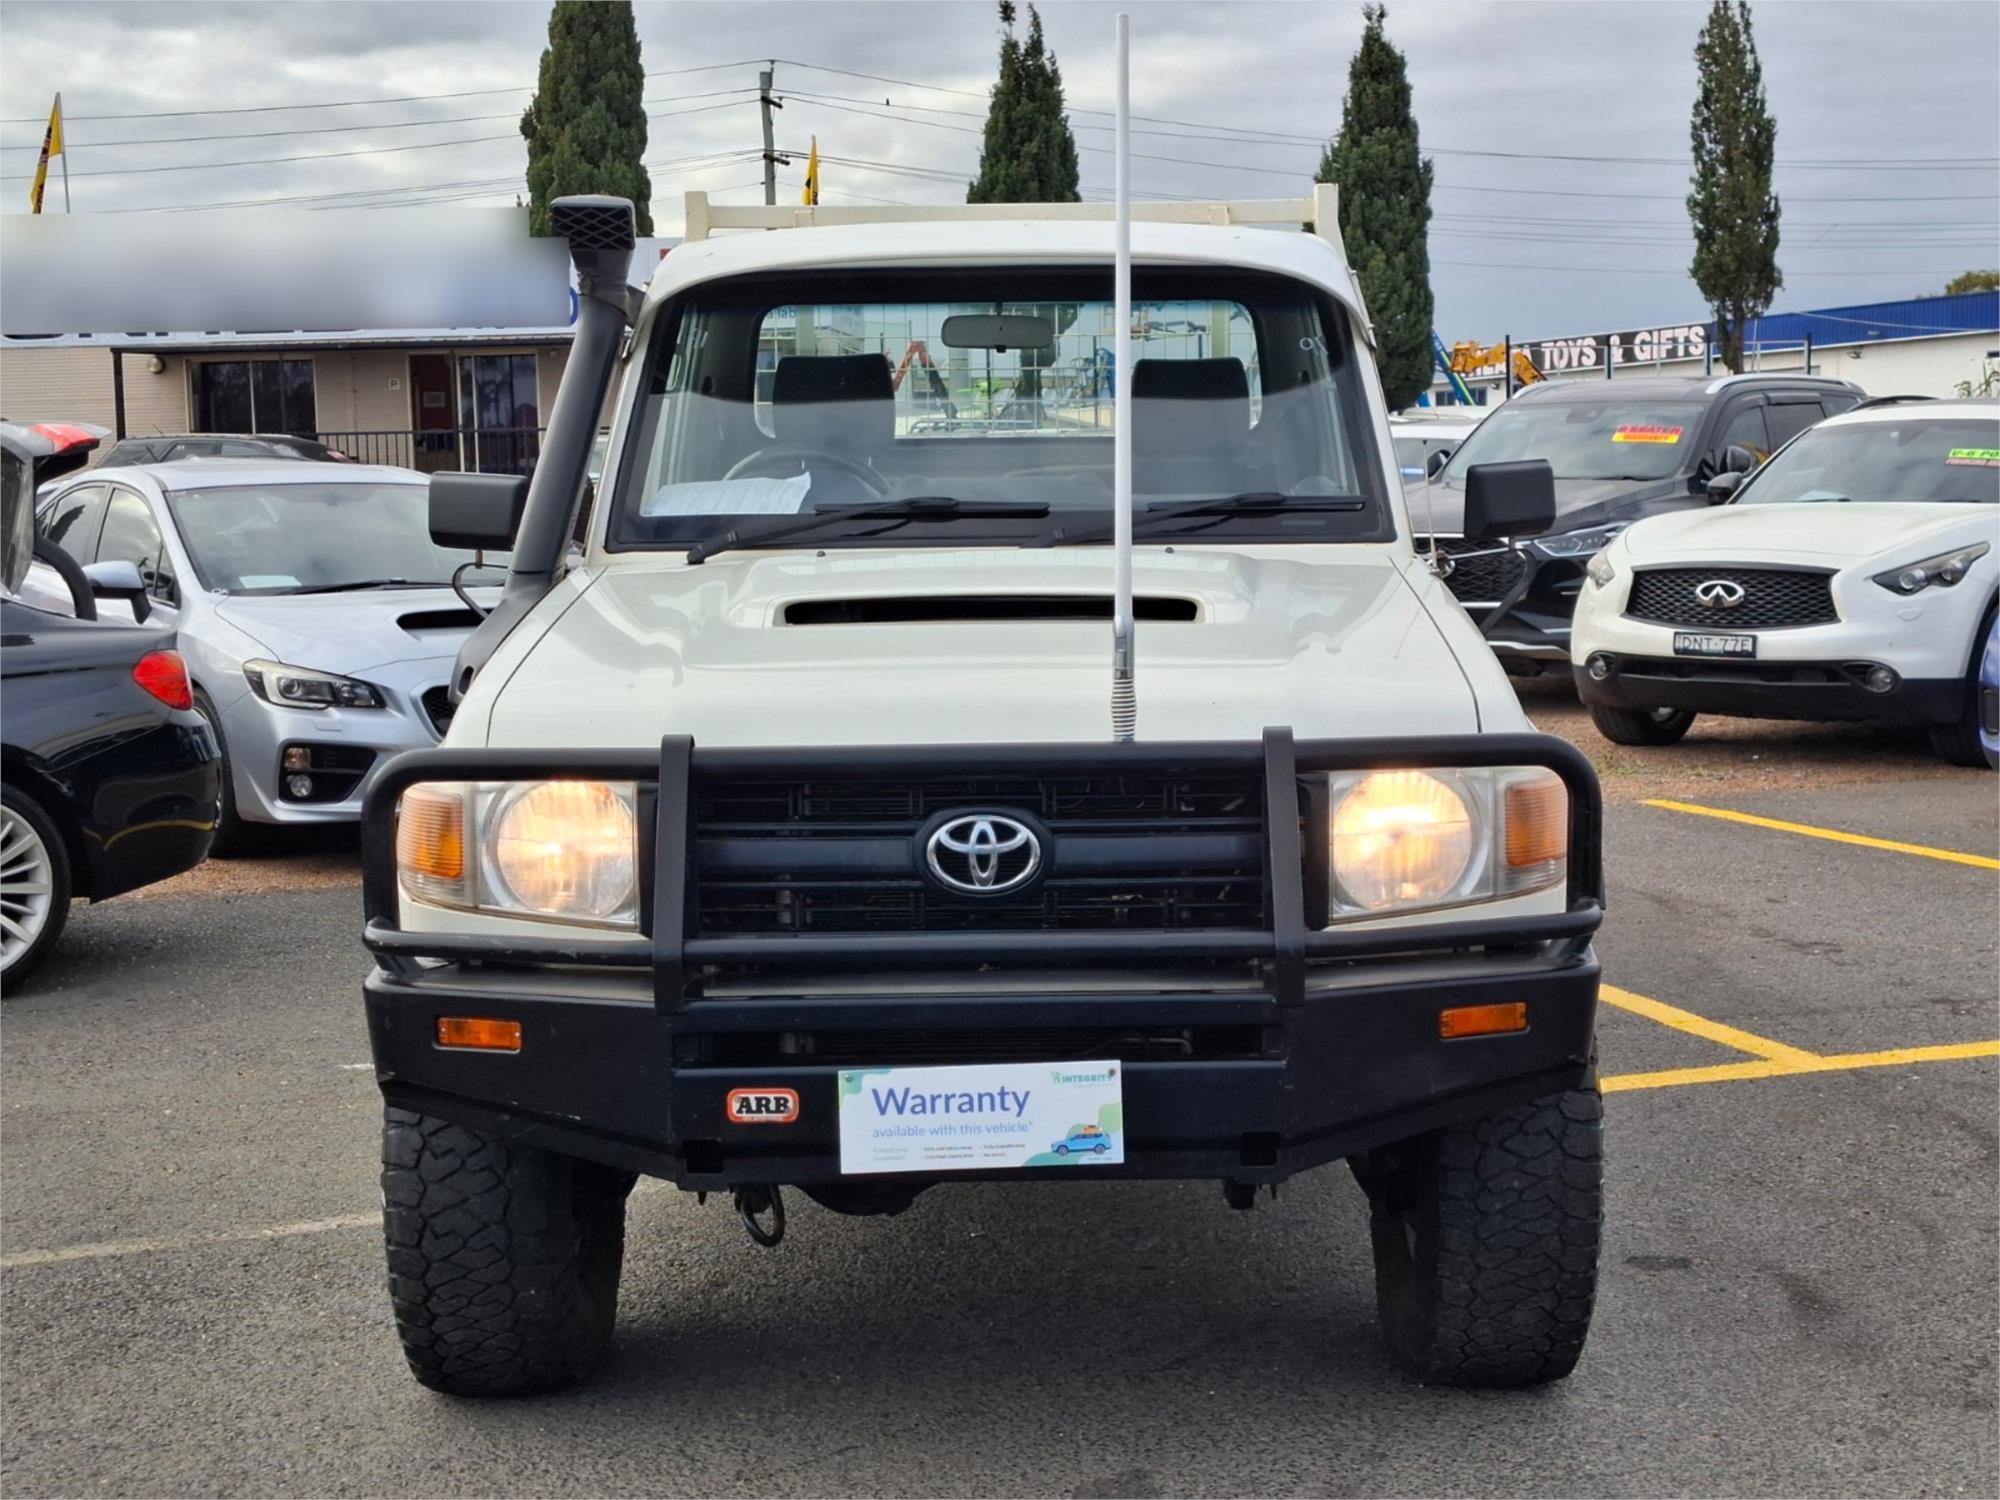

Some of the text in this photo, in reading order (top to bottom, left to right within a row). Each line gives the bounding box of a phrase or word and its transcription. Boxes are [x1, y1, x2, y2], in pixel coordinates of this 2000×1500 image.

[1541, 337, 1597, 370] TOYS
[1634, 325, 1705, 361] GIFTS
[735, 1096, 792, 1114] ARB
[871, 1085, 1030, 1117] Warranty
[872, 1125, 926, 1138] available
[929, 1123, 957, 1136] with
[960, 1122, 982, 1135] this
